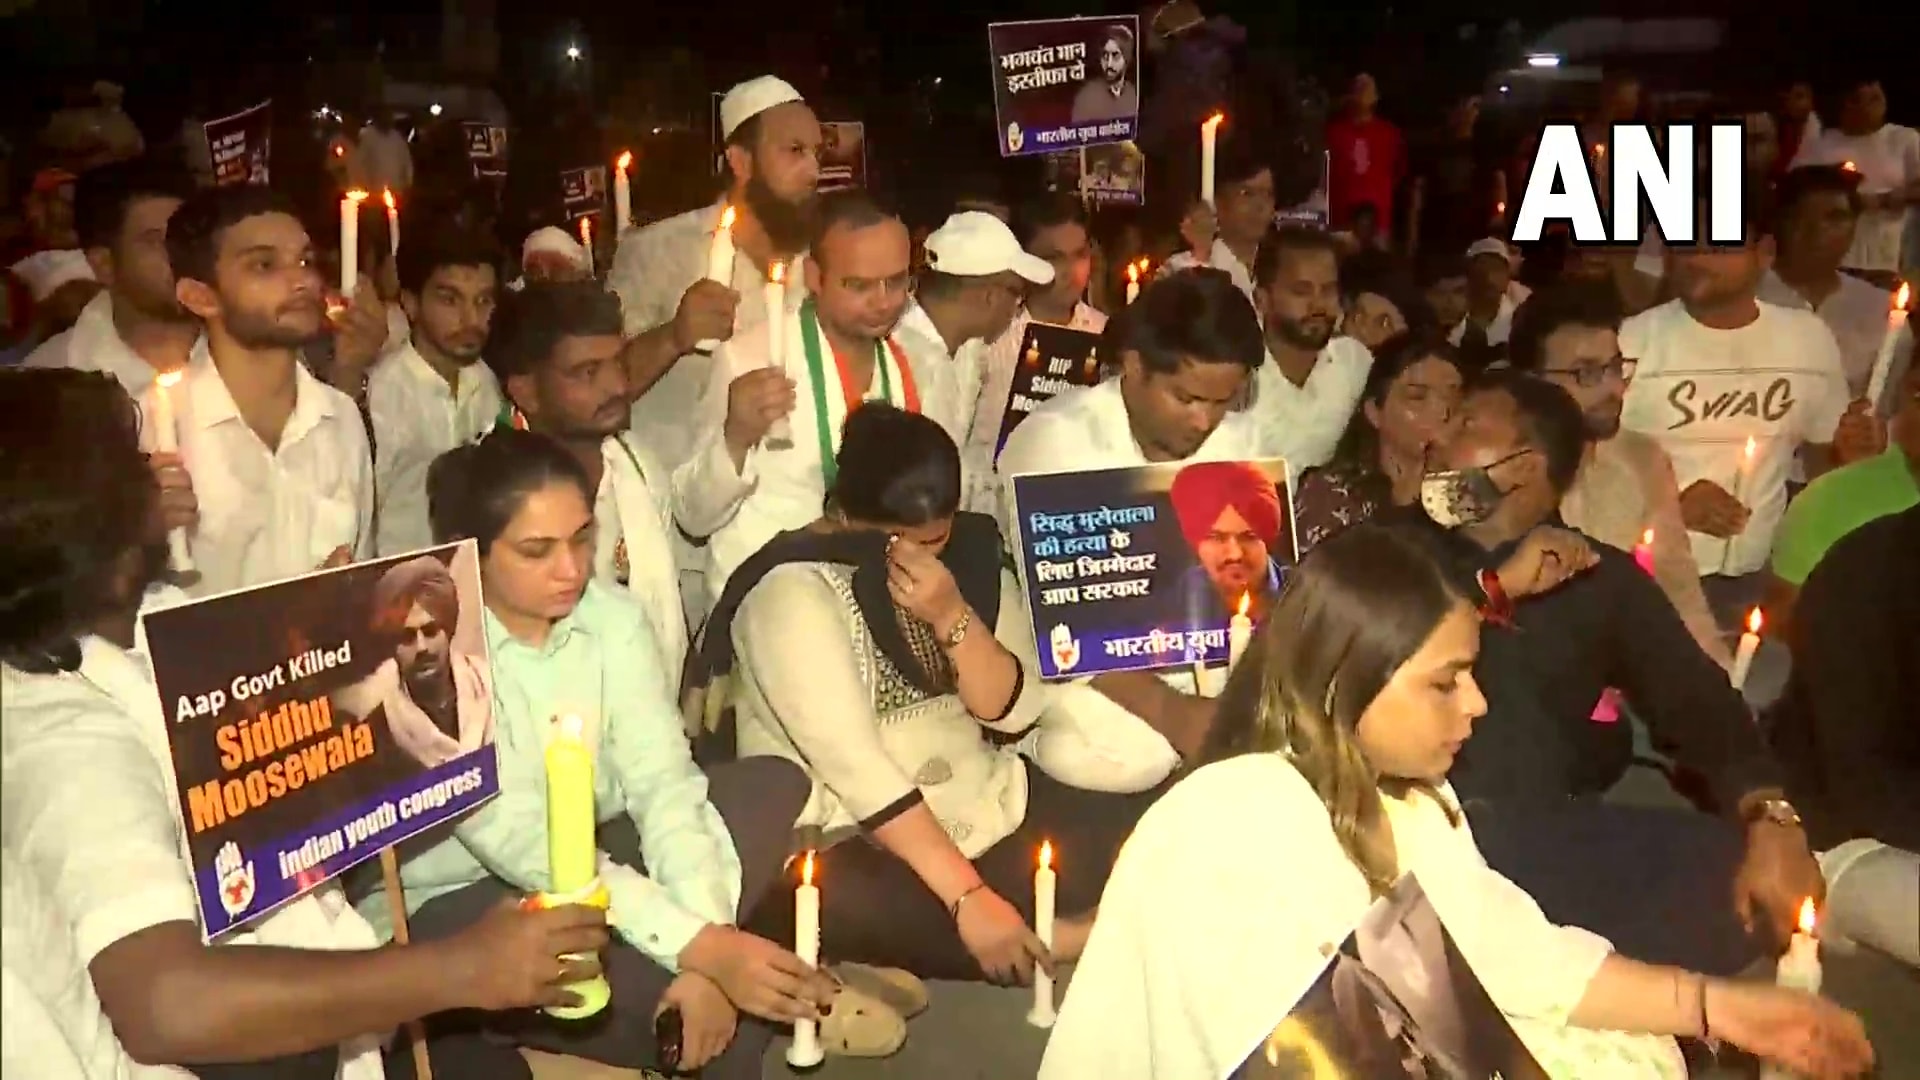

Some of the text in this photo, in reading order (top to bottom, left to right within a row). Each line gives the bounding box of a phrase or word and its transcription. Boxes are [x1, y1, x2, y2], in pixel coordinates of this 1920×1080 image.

[1000, 45, 1054, 70] भगवंत
[1006, 60, 1085, 93] इस्तीफा दो
[1048, 356, 1072, 375] RIP
[1033, 536, 1060, 556] की
[1109, 528, 1131, 548] के
[1036, 561, 1075, 582] लिए
[1041, 579, 1150, 606] आप सरकार
[1103, 629, 1225, 657] भारतीय युवा
[176, 640, 351, 723] Aap Govt Killed
[216, 696, 333, 771] Siddhu
[188, 723, 375, 833] Moosewala
[344, 800, 398, 849] youth
[399, 766, 483, 819] congress
